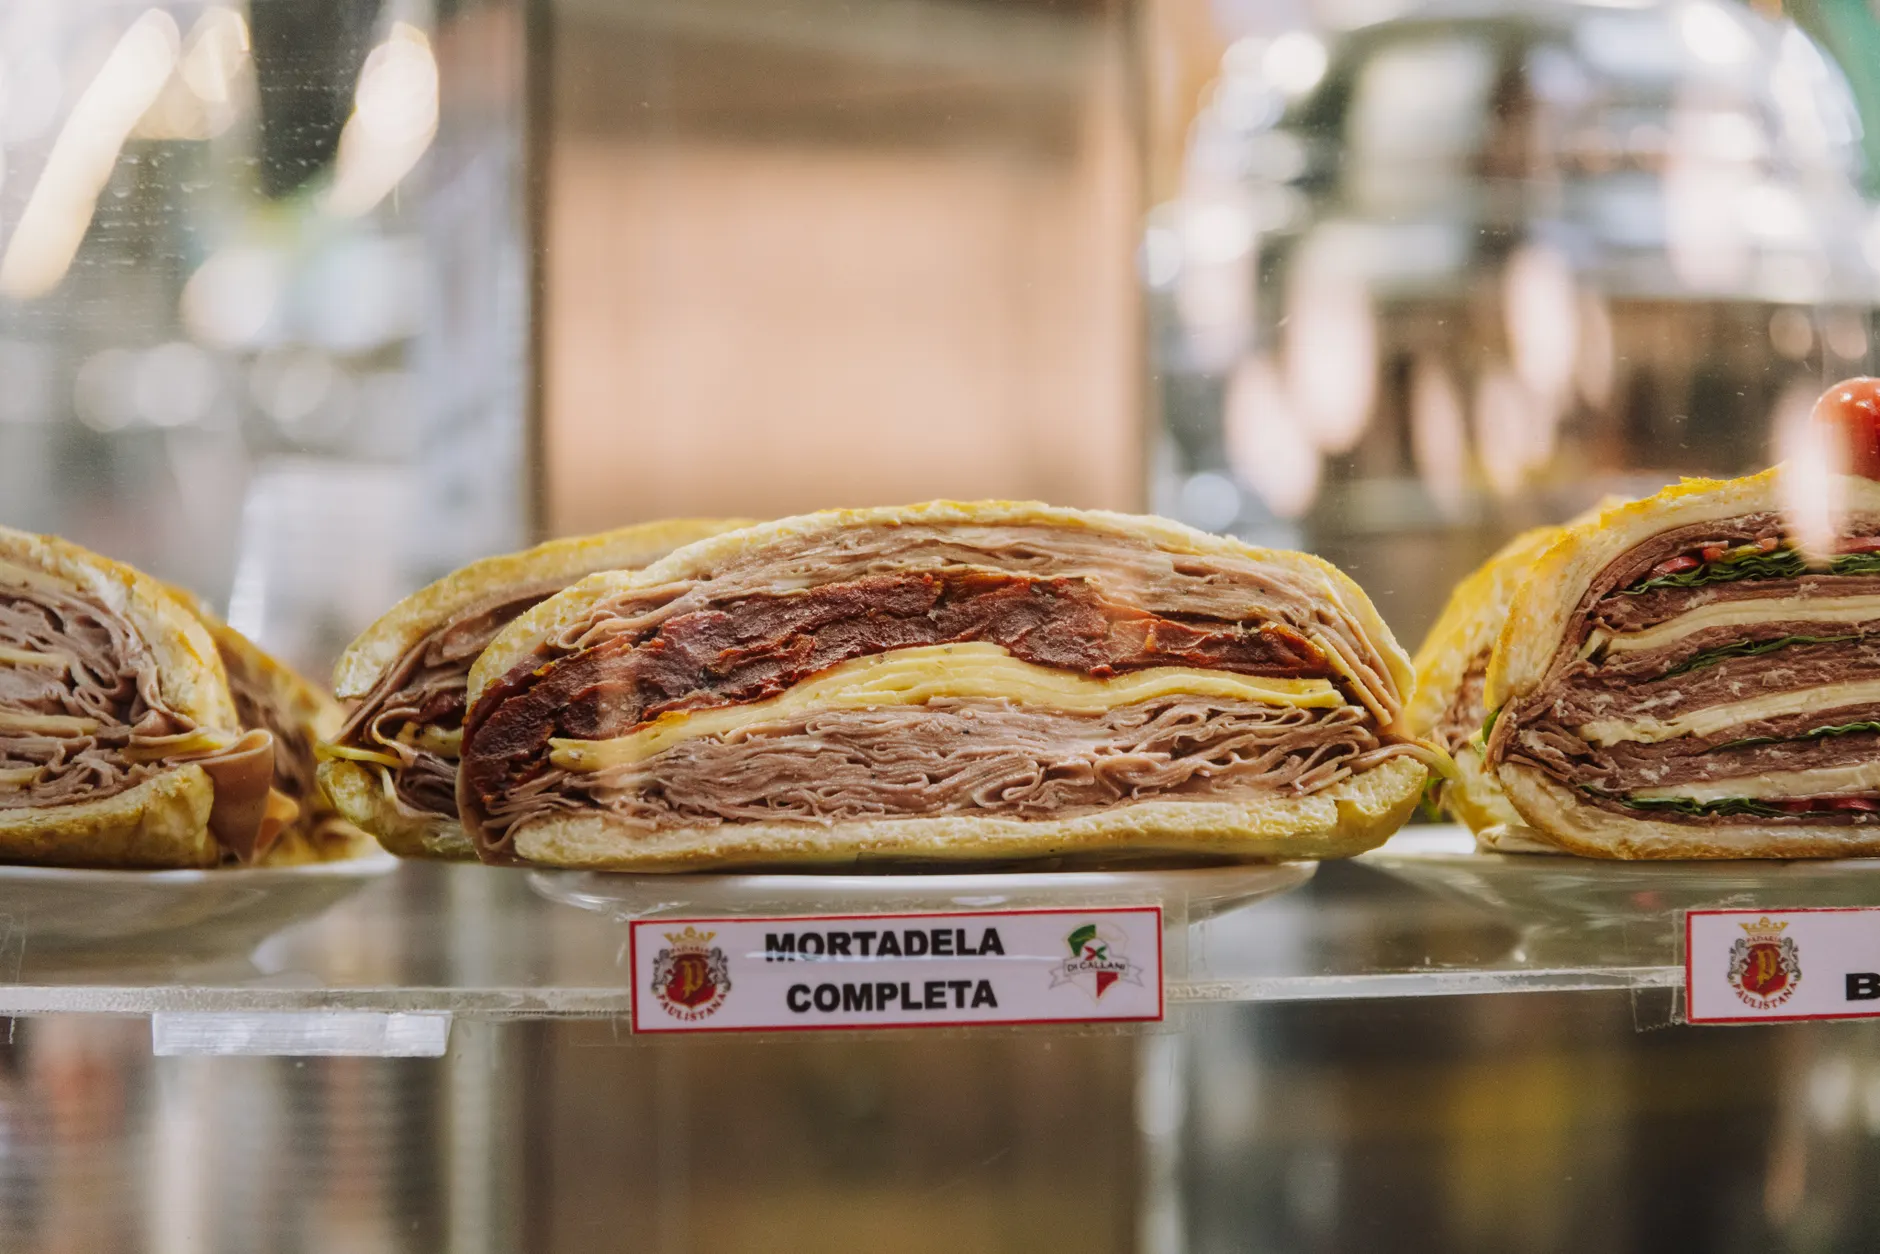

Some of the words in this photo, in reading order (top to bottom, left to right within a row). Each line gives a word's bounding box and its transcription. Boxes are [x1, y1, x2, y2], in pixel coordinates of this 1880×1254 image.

[765, 928, 1005, 962] MORTADELA
[786, 979, 998, 1013] COMPLETA
[1732, 981, 1797, 1010] PAULISTANA
